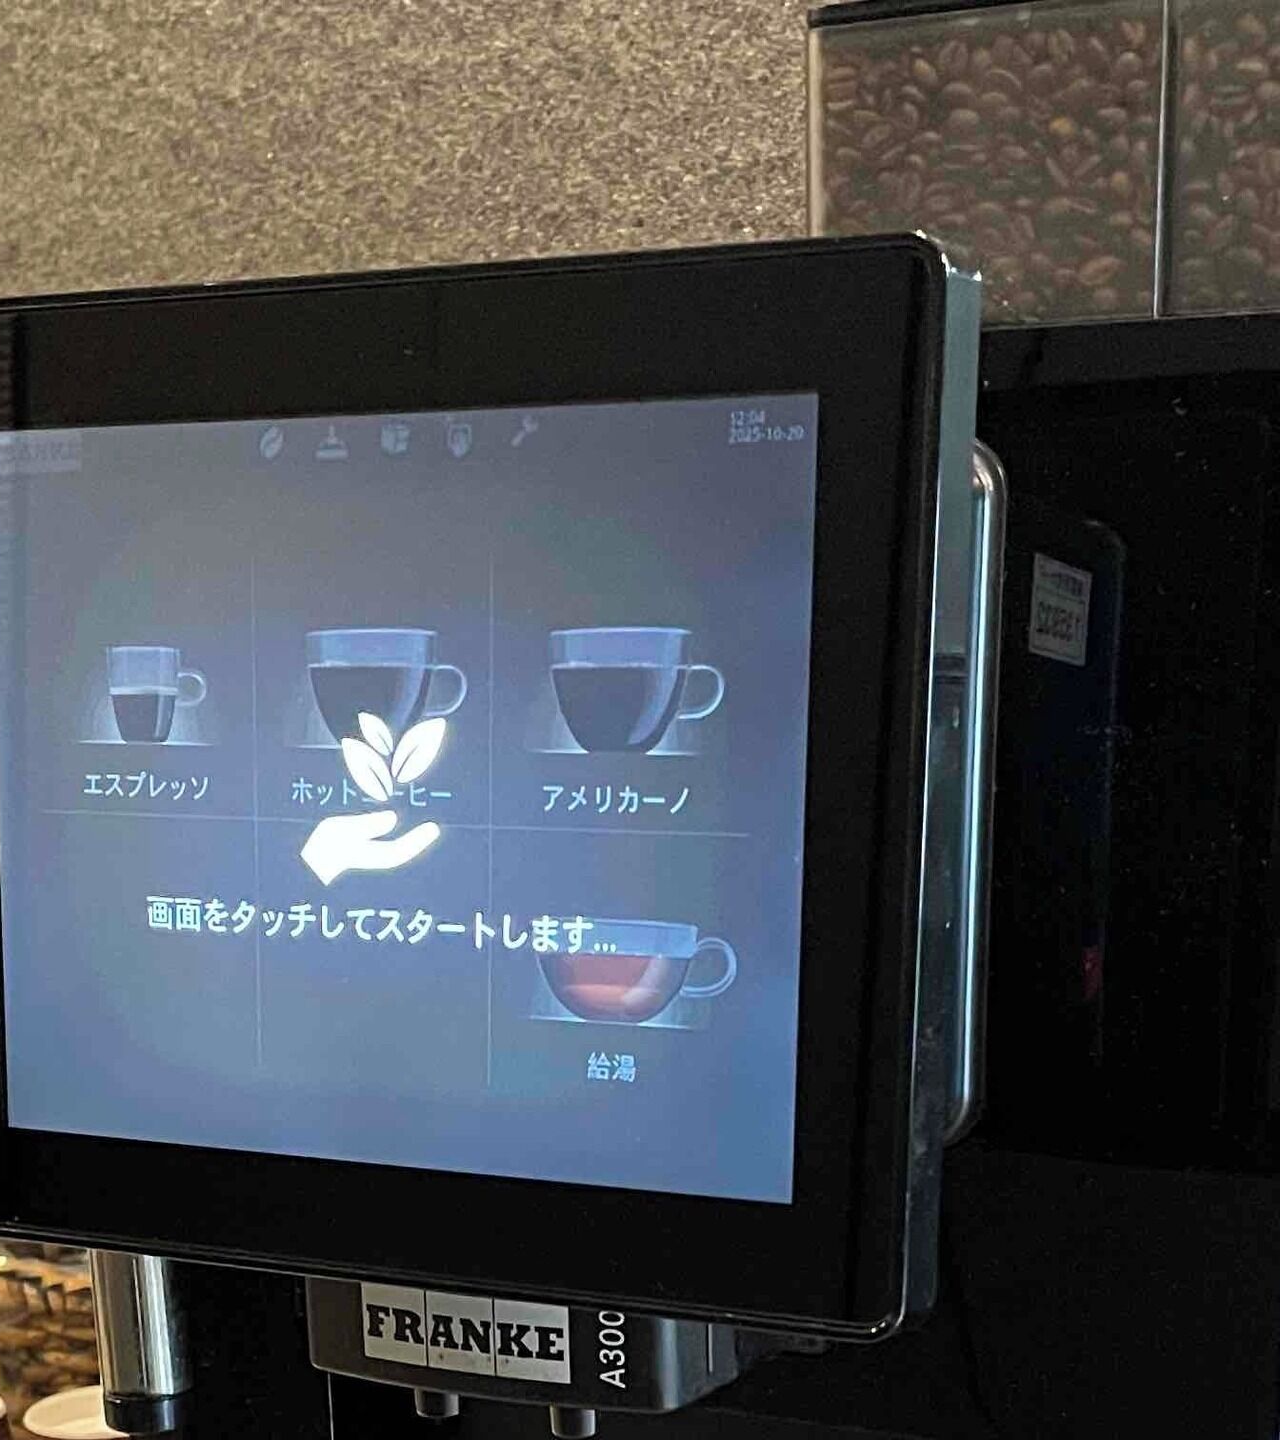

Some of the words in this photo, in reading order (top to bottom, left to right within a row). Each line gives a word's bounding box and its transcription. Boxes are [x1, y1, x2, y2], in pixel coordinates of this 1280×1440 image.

[83, 771, 209, 800] エスプレッソ
[292, 777, 452, 807] ホットーヒー
[543, 785, 689, 814] アメリカーノ
[587, 1051, 636, 1082] 給湯
[366, 1303, 565, 1362] FRANKE
[599, 1310, 626, 1388] A300
